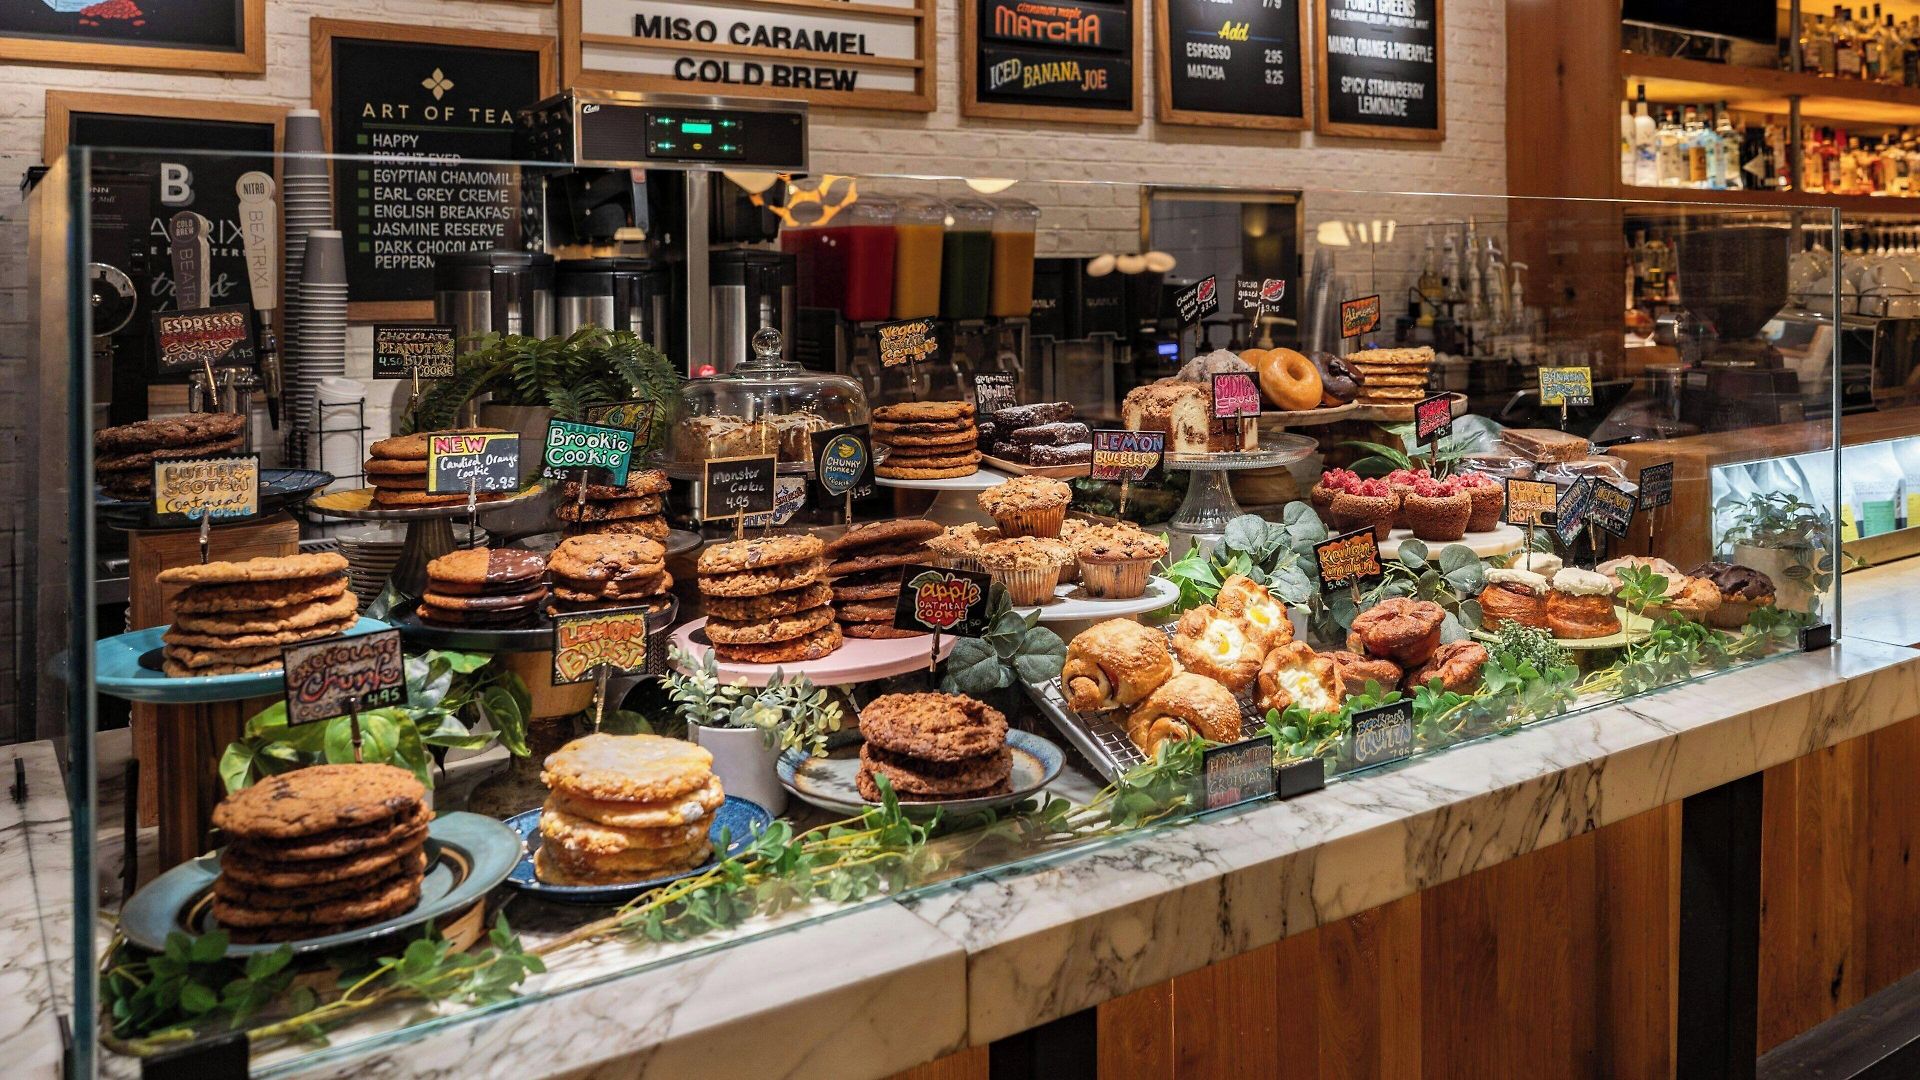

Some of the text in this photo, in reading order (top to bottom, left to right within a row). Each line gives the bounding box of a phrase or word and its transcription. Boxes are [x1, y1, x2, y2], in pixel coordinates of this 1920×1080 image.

[1017, 3, 1056, 16] cinnamon
[995, 5, 1100, 45] MATCHA
[1218, 20, 1250, 41] Add
[633, 14, 875, 56] MISO CARAMEL
[1186, 42, 1283, 64] ESPRESSO 2.95
[1357, 38, 1387, 59] ORANGE
[1387, 41, 1394, 60] &
[1394, 42, 1433, 63] PINEAPPLE
[674, 56, 858, 92] COLD BREW
[990, 58, 1107, 91] ICED BANANA JOE
[1187, 63, 1284, 85] MATCHA 3.25
[1341, 75, 1425, 100] SPICY STRAWBERRY
[362, 103, 514, 124] ART OF TEA
[1358, 95, 1408, 117] LEMONADE
[372, 133, 419, 148] HAPPY
[373, 151, 425, 166] BRIGHT
[160, 162, 195, 206] B
[373, 169, 521, 187] EGYPTIAN CHAMOMILE
[243, 183, 265, 195] NITRO
[374, 187, 509, 204] EARL GREY CREME
[374, 204, 517, 220] ENGLISH BREAKFAST
[175, 227, 194, 238] BREW
[176, 219, 193, 228] COLD
[373, 222, 505, 237] JASMINE RESERVE
[248, 210, 269, 282] BEATRIX
[375, 240, 495, 254] DARK CHOCOLATE
[1238, 290, 1258, 301] glazed
[162, 313, 244, 334] ESPRESSO
[879, 322, 929, 341] Vegan
[165, 338, 234, 356] CHIP
[377, 341, 434, 355] PEANUT
[379, 354, 455, 367] 4.50 BUTTER
[421, 365, 455, 377] COOKIE
[1543, 371, 1588, 383] BANANA
[434, 436, 487, 454] NEW
[549, 427, 629, 452] Brookie
[1097, 433, 1163, 452] LEMON
[440, 453, 518, 471] Candied Orange
[548, 447, 620, 466] Cookie
[826, 456, 861, 469] CHUNKY
[1094, 451, 1159, 469] BLUEBERRY
[456, 465, 490, 480] Cookie
[543, 466, 570, 480] 6.95
[712, 466, 760, 485] Monster
[825, 466, 856, 476] Monkey
[163, 475, 250, 498] SCOTCH
[485, 476, 516, 490] 2.95
[730, 481, 765, 493] Cookie
[850, 485, 871, 499] 4.95
[166, 494, 249, 513] Oatmeal
[726, 495, 749, 508] 4.95
[920, 581, 979, 604] apple
[918, 610, 965, 619] COOKIE
[919, 601, 965, 611] OATMEAL
[560, 618, 643, 648] LEMON
[287, 637, 398, 691] CHOCOLATE
